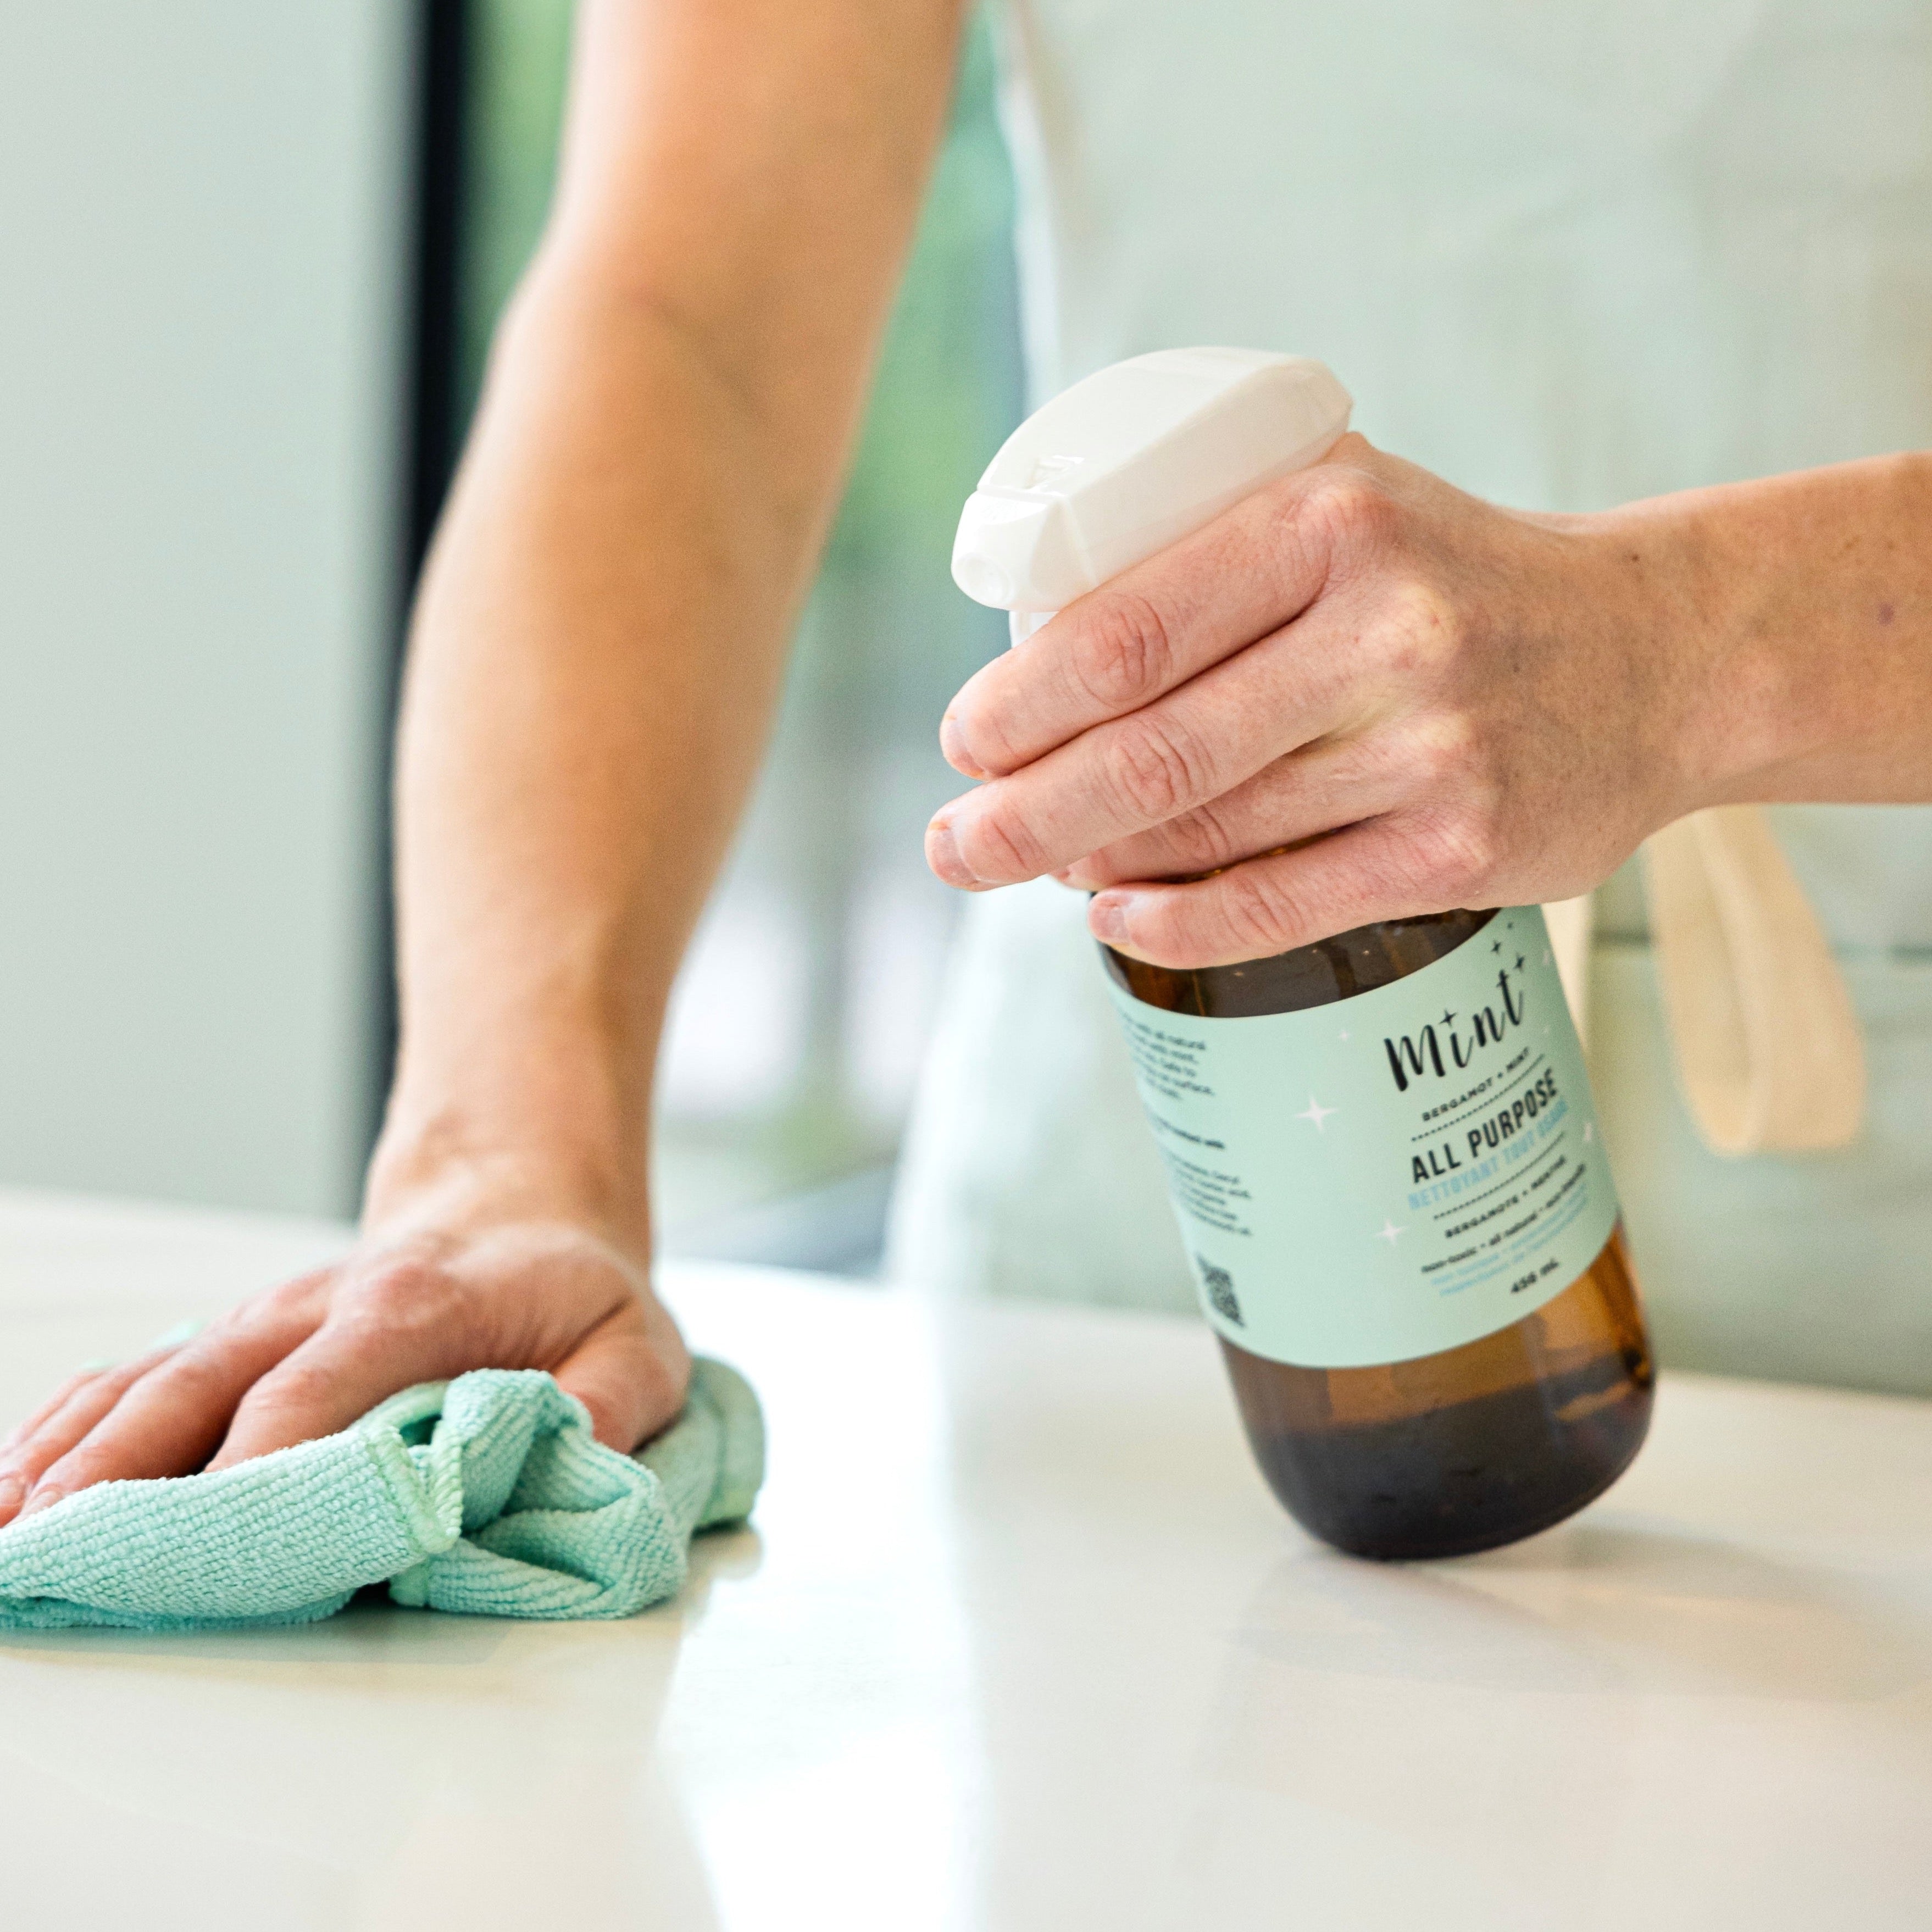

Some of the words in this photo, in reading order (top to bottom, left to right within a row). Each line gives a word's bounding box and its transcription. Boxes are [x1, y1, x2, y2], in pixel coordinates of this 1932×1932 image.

[1384, 969, 1524, 1092] Mint
[1412, 1143, 1462, 1184] ALL
[1467, 1067, 1558, 1158] PURPOSE
[1422, 1077, 1493, 1122] BERGAMOT
[1408, 1156, 1500, 1210] NETTOYANT
